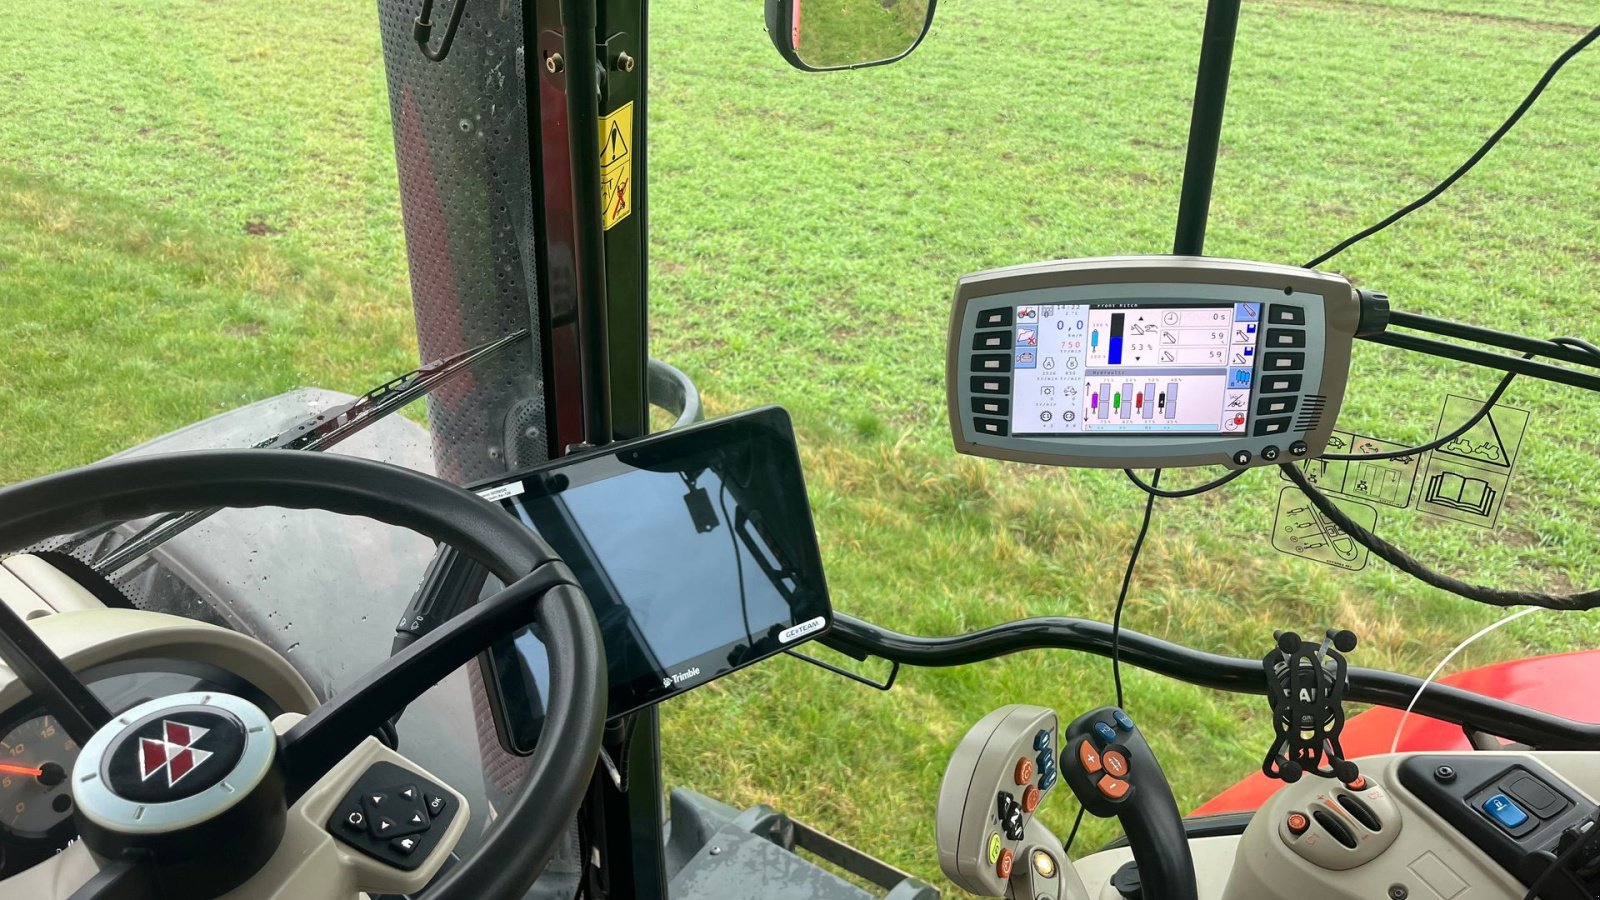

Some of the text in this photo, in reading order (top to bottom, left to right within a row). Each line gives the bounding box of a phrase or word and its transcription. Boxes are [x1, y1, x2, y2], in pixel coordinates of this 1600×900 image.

[1056, 320, 1084, 332] 0,0
[1131, 343, 1144, 351] 53
[671, 667, 701, 685] Trimble
[40, 725, 56, 739] 15
[9, 743, 25, 757] 10
[2, 776, 12, 788] 5
[15, 801, 25, 813] 0
[431, 796, 442, 808] OK
